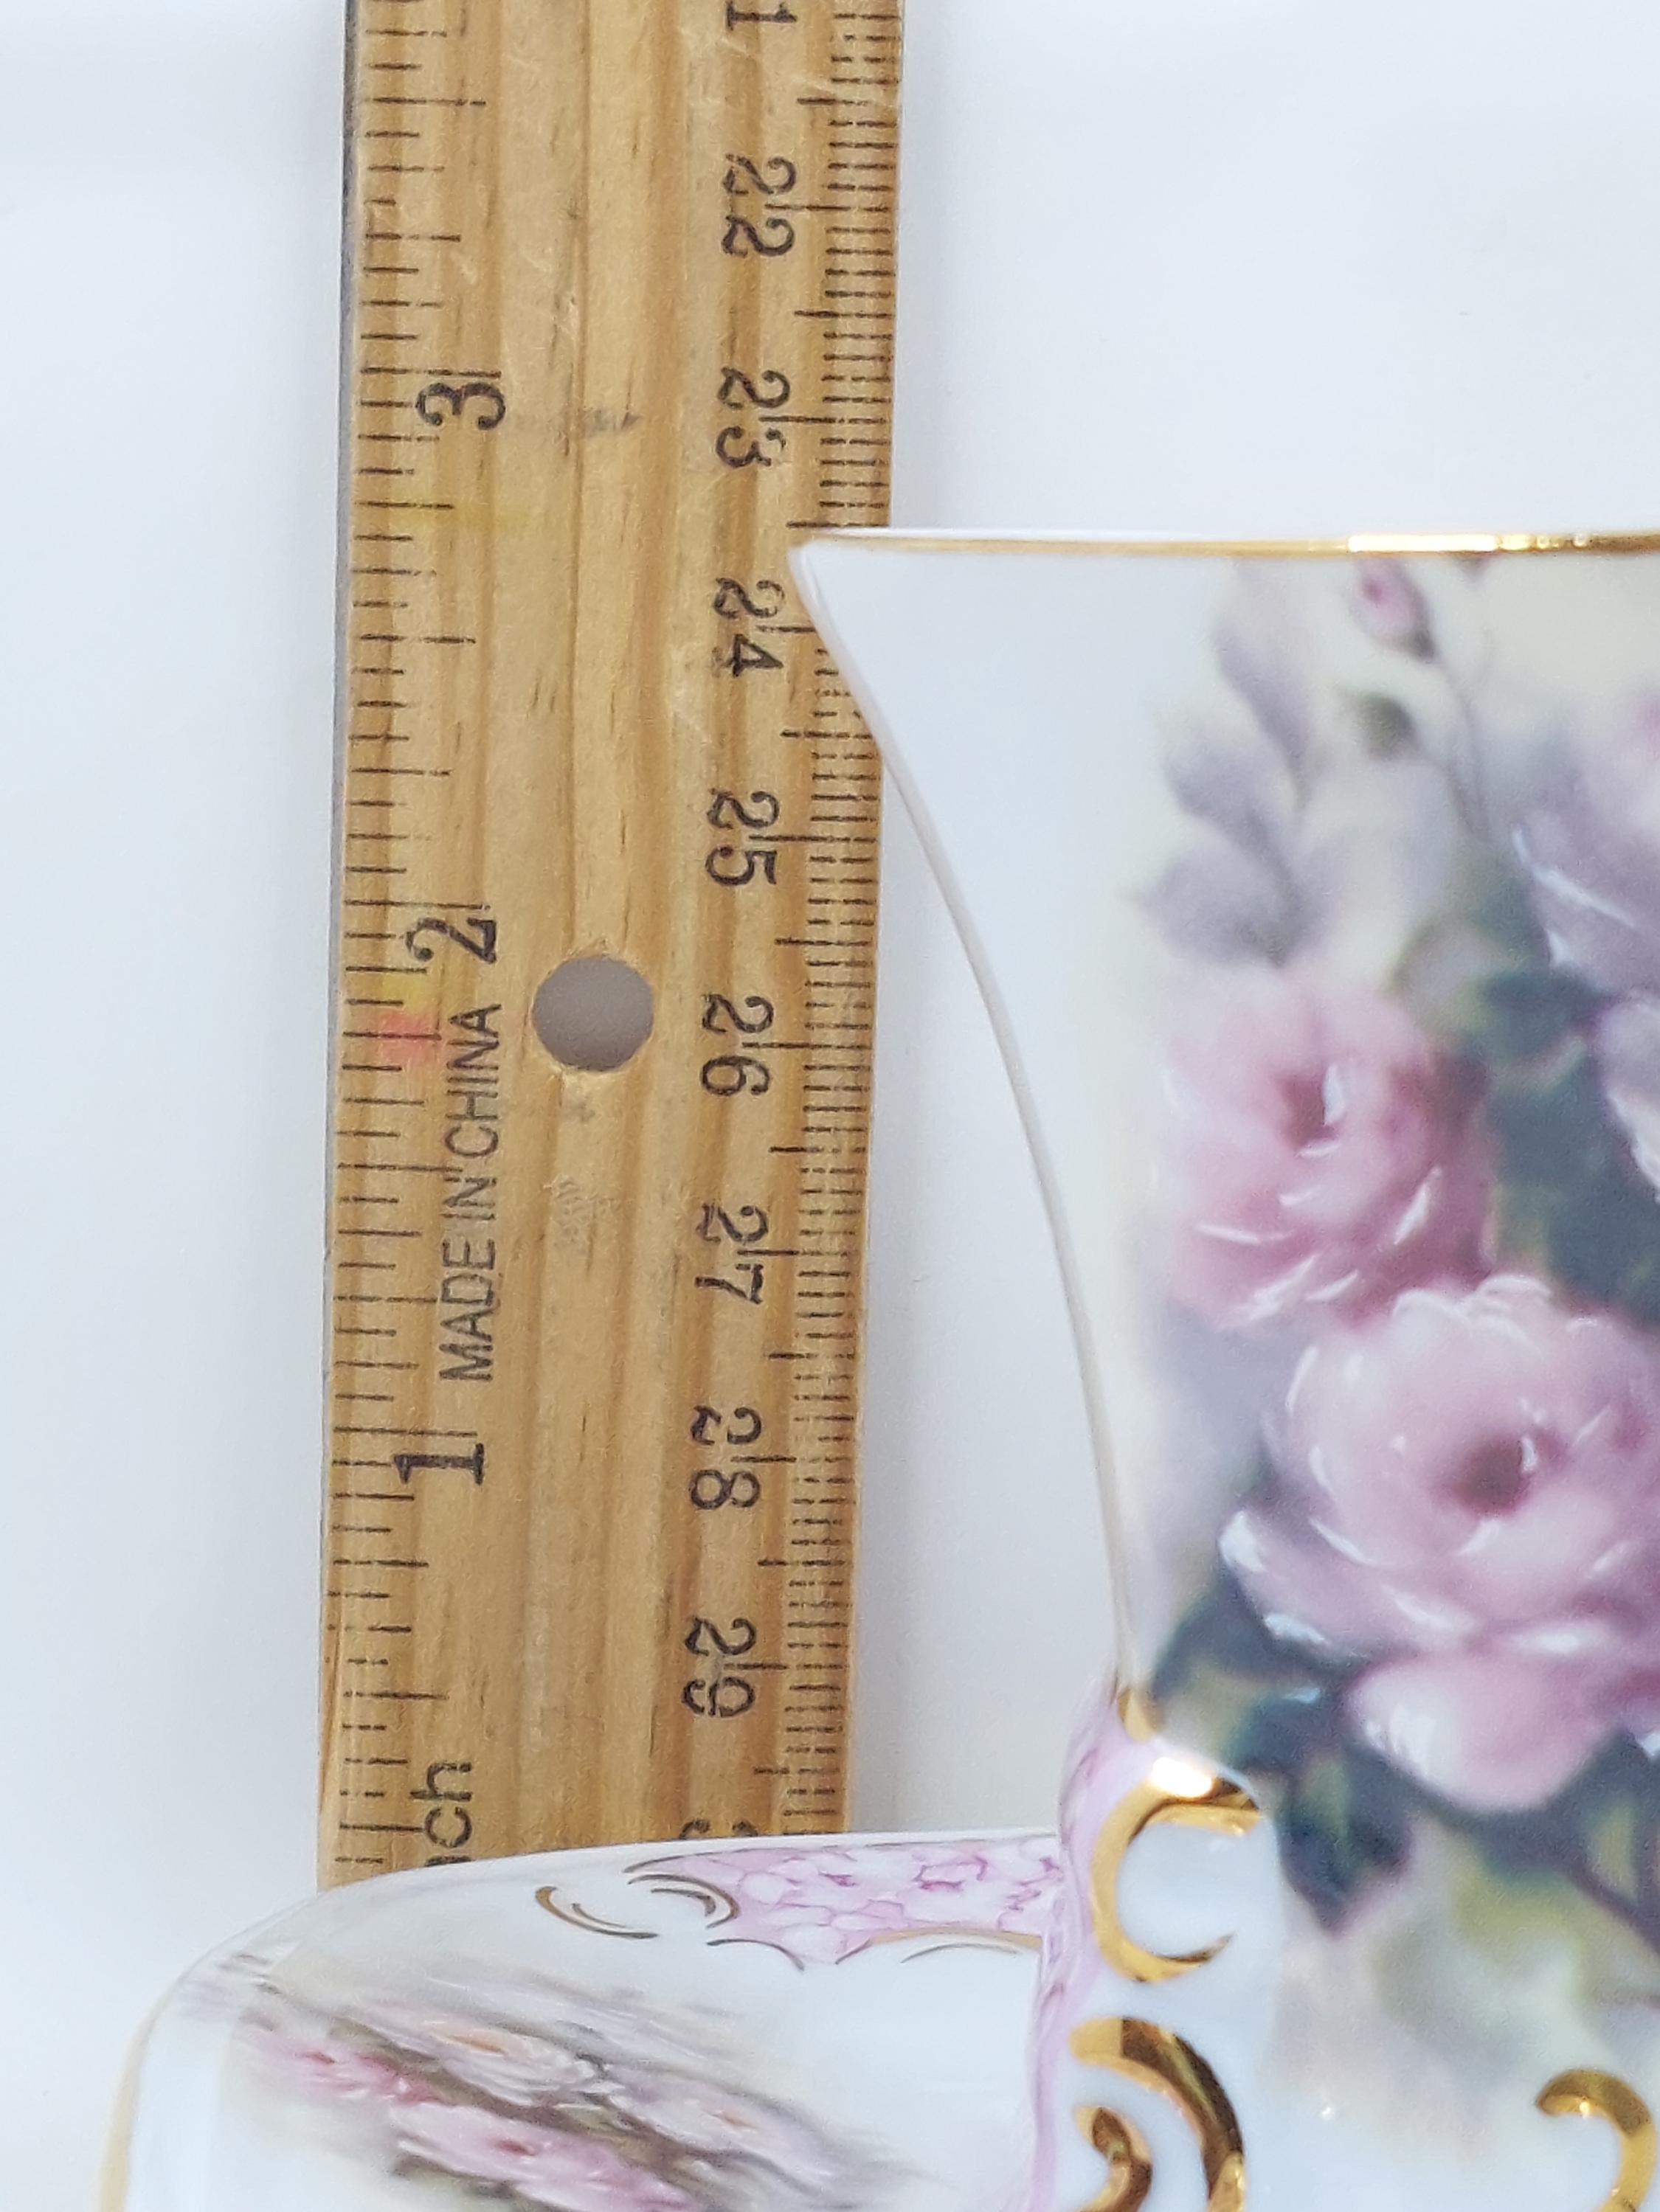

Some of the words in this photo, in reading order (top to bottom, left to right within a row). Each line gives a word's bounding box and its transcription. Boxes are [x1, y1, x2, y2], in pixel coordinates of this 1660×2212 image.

[721, 153, 796, 257] 22
[416, 382, 506, 430] 3
[716, 367, 791, 468] 23
[713, 577, 785, 678] 24
[705, 788, 781, 887] 25
[405, 917, 497, 964] 2
[444, 1003, 502, 1159] CHINA
[700, 993, 774, 1098] 26
[443, 1177, 498, 1221] IN
[695, 1203, 769, 1305] 27
[438, 1238, 497, 1383] MADE
[393, 1443, 485, 1485] 1
[688, 1406, 763, 1511] 28
[682, 1617, 757, 1719] 29
